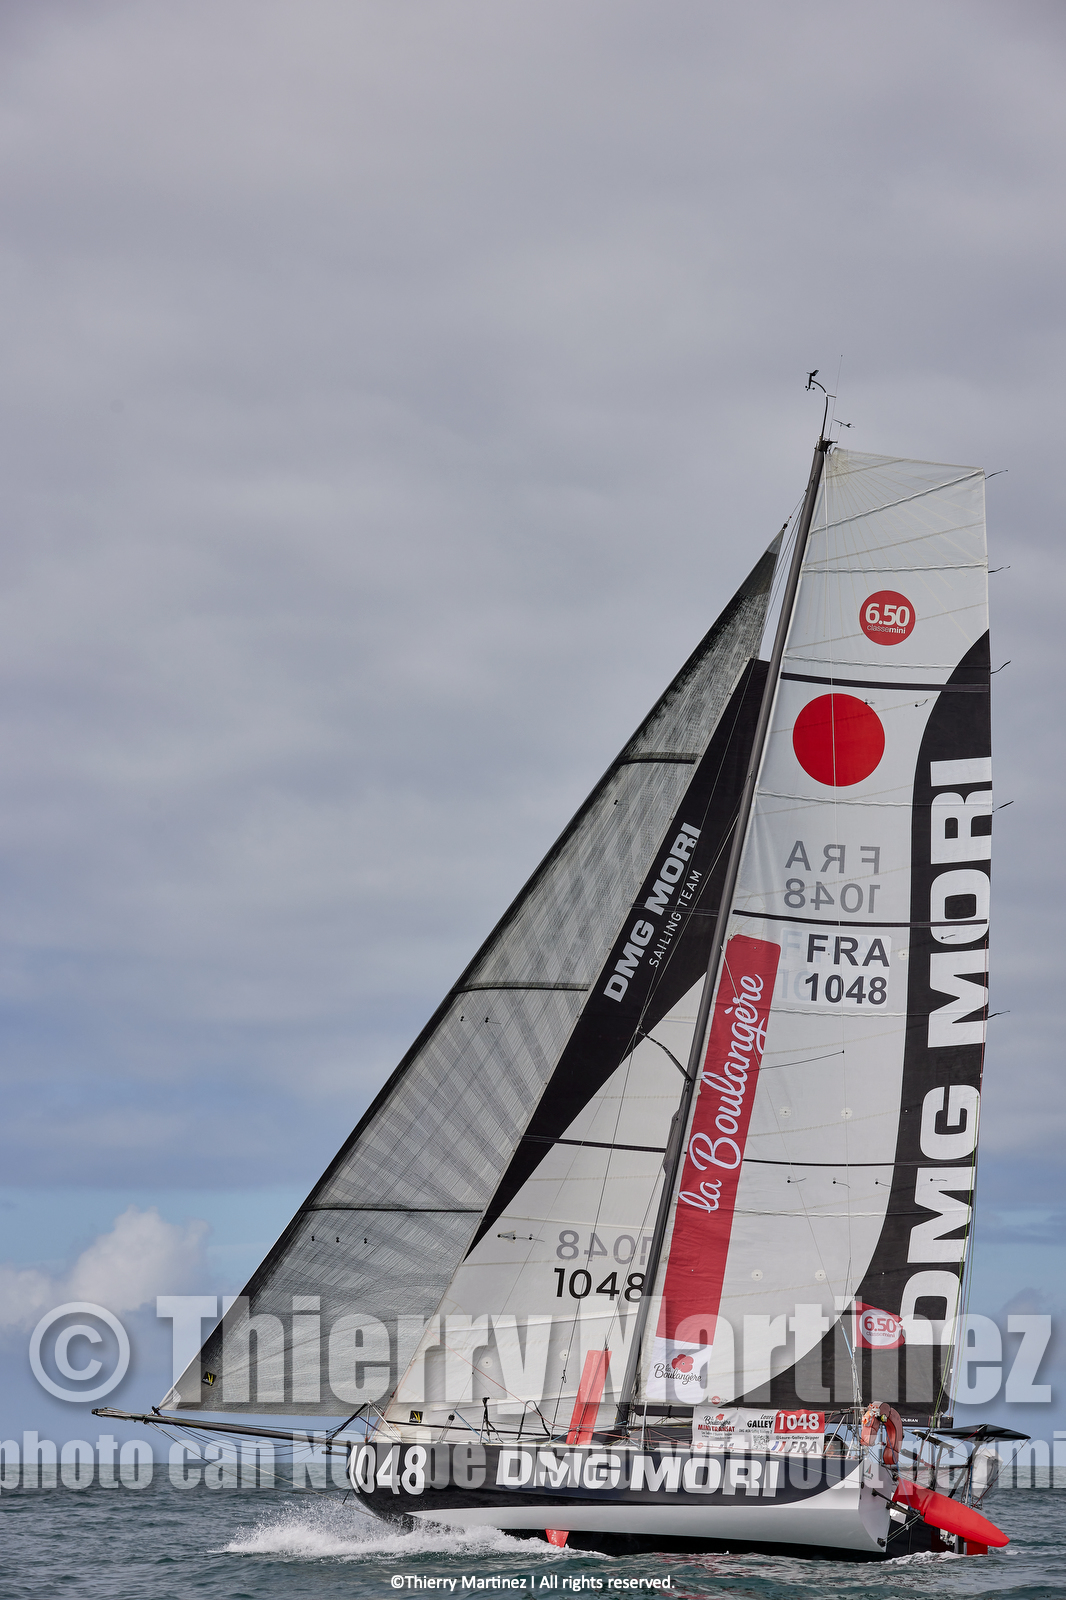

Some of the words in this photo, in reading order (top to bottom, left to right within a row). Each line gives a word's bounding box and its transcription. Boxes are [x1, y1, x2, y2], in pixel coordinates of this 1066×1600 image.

[865, 602, 910, 627] 6.50
[867, 624, 906, 634] classemini
[603, 919, 655, 1003] DMG
[644, 822, 702, 916] MORI
[649, 912, 682, 968] SAILING
[677, 869, 703, 907] TEAM
[927, 757, 992, 1048] MORI
[806, 933, 890, 967] FRA
[805, 973, 887, 1005] 1048
[689, 973, 767, 1171] Boulangère
[678, 1178, 723, 1214] la
[900, 1084, 981, 1345] DMG
[554, 1267, 646, 1303] 1048
[864, 1315, 897, 1333] 6.50
[747, 1420, 773, 1428] GALLEY
[778, 1413, 820, 1430] 1048
[788, 1440, 818, 1454] FRA
[347, 1445, 427, 1495] 1048
[496, 1450, 622, 1490] DMG
[630, 1455, 780, 1498] MORI
